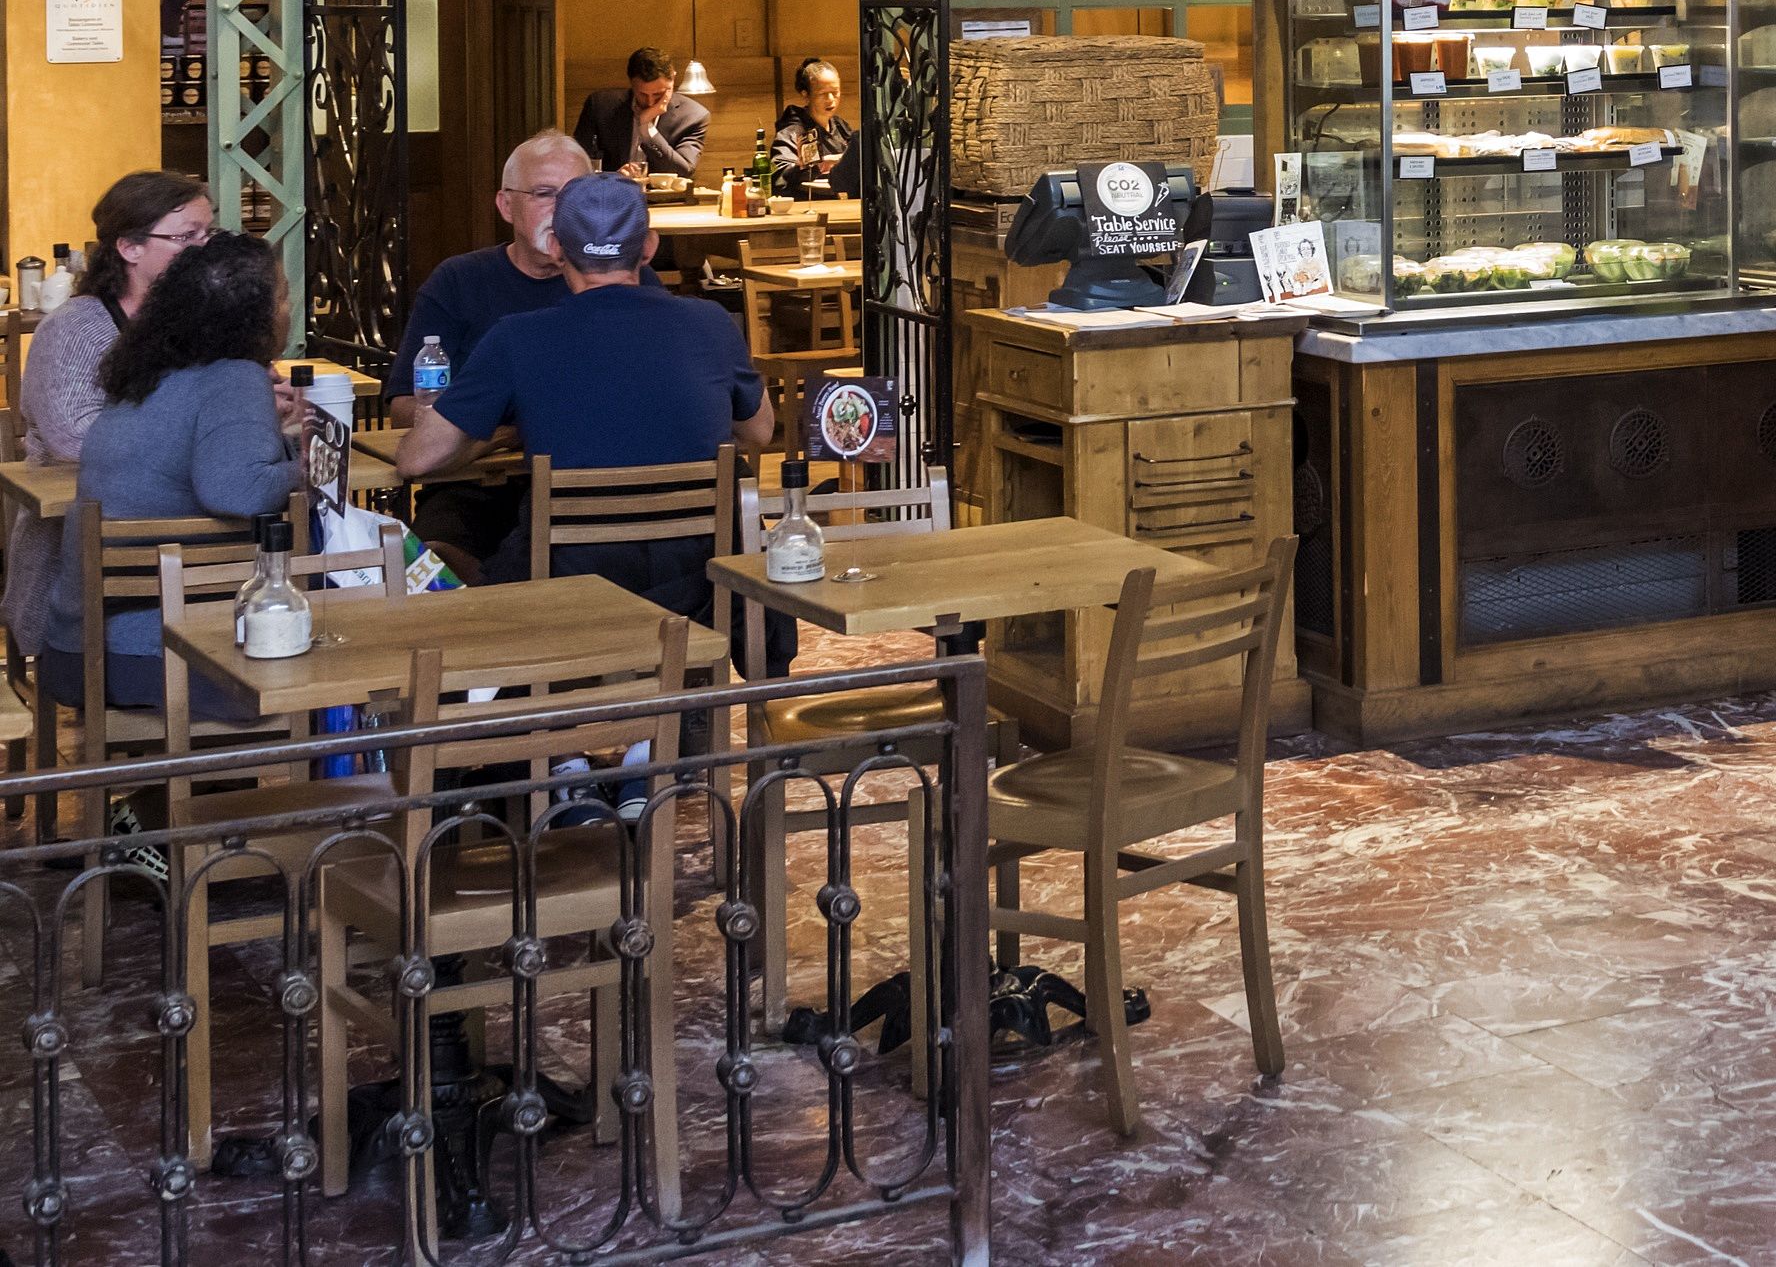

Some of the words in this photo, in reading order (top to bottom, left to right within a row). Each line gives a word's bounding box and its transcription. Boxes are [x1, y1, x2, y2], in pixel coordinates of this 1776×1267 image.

[1107, 179, 1140, 191] CO2
[1091, 215, 1133, 232] Table
[1133, 212, 1176, 231] Service
[1092, 232, 1132, 247] please
[1099, 244, 1127, 255] SEAT
[1130, 241, 1179, 254] YOURSELF
